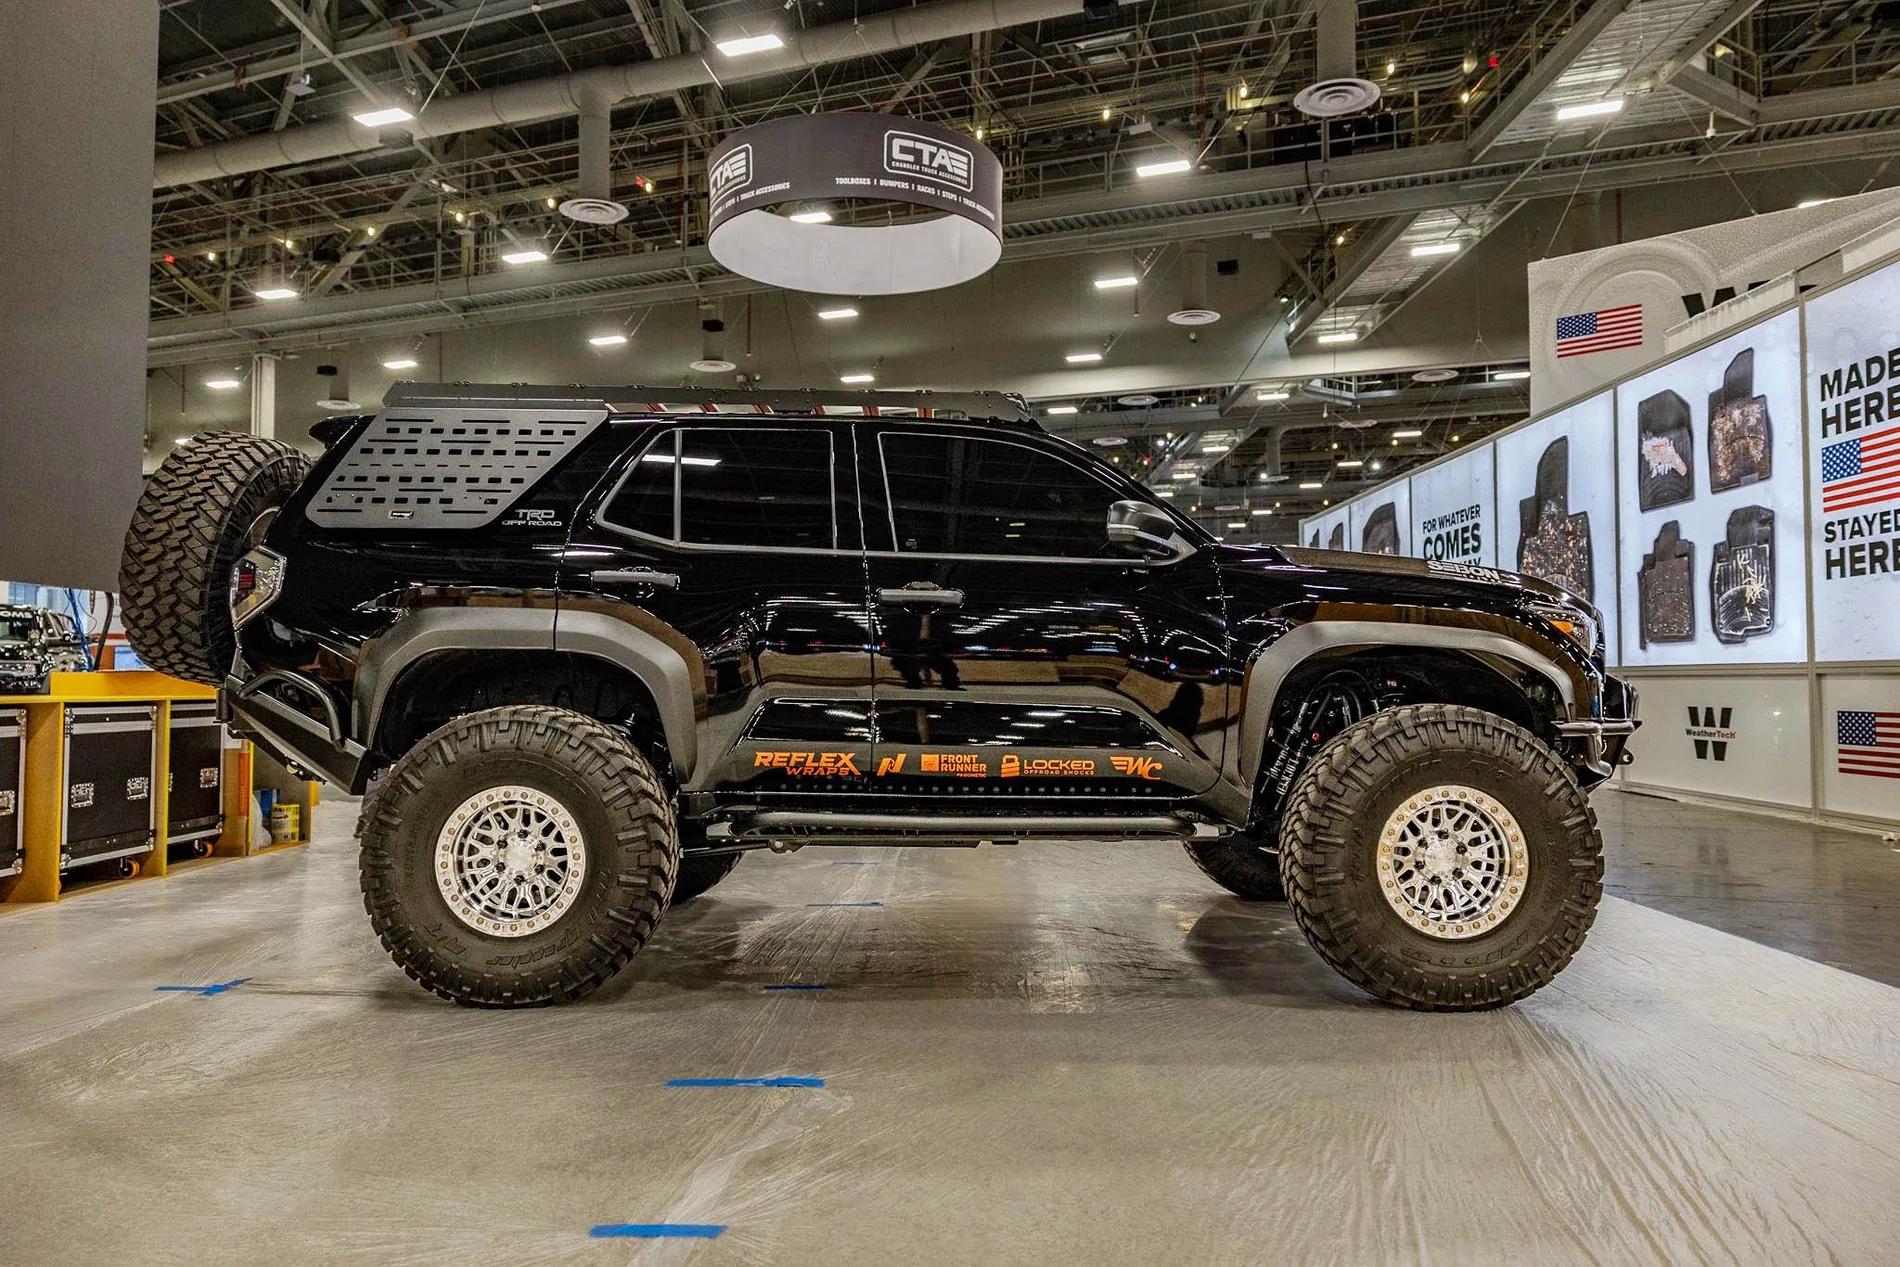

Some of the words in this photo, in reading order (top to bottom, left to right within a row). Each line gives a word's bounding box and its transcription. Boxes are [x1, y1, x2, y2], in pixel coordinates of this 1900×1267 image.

[835, 177, 871, 185] TOOLBOXES
[879, 179, 910, 190] BUMPERS
[917, 184, 936, 195] RACKS
[942, 190, 958, 201] STEPS
[1820, 347, 1900, 402] MADE
[1822, 384, 1900, 439] HERE
[515, 509, 555, 520] TRD
[1423, 518, 1437, 534] FOR
[1438, 504, 1481, 530] WHATEVER
[1423, 522, 1481, 561] COMES
[1685, 728, 1736, 739] WeatherTech
[754, 752, 861, 775] REFLEX
[941, 754, 978, 763] FRONT
[1023, 760, 1095, 770] LOCKED
[786, 767, 850, 776] WRAPS
[941, 763, 987, 772] RUNNER
